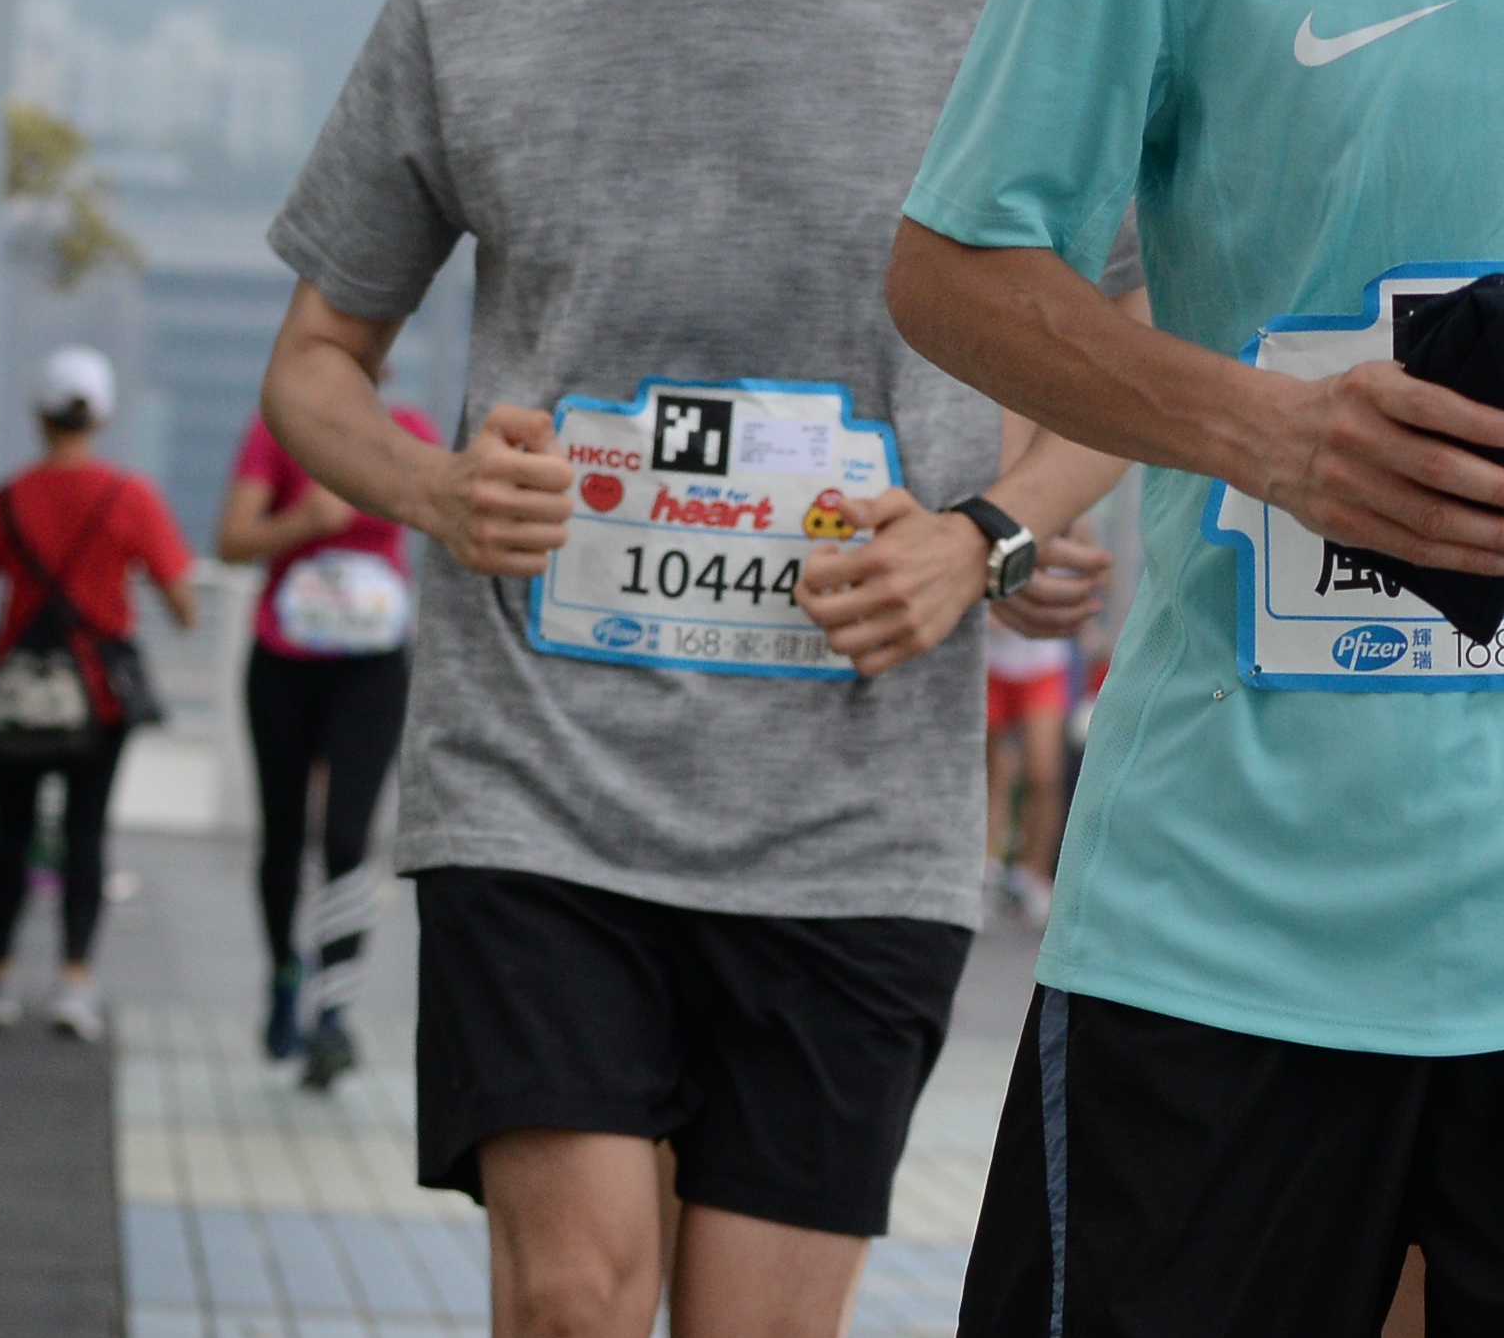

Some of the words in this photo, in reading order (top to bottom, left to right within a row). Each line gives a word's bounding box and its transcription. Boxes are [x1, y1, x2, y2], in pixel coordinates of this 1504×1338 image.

[568, 444, 642, 471] HKCC
[650, 483, 774, 531] heart
[620, 545, 802, 606] 10444
[1337, 631, 1407, 671] Pfizer
